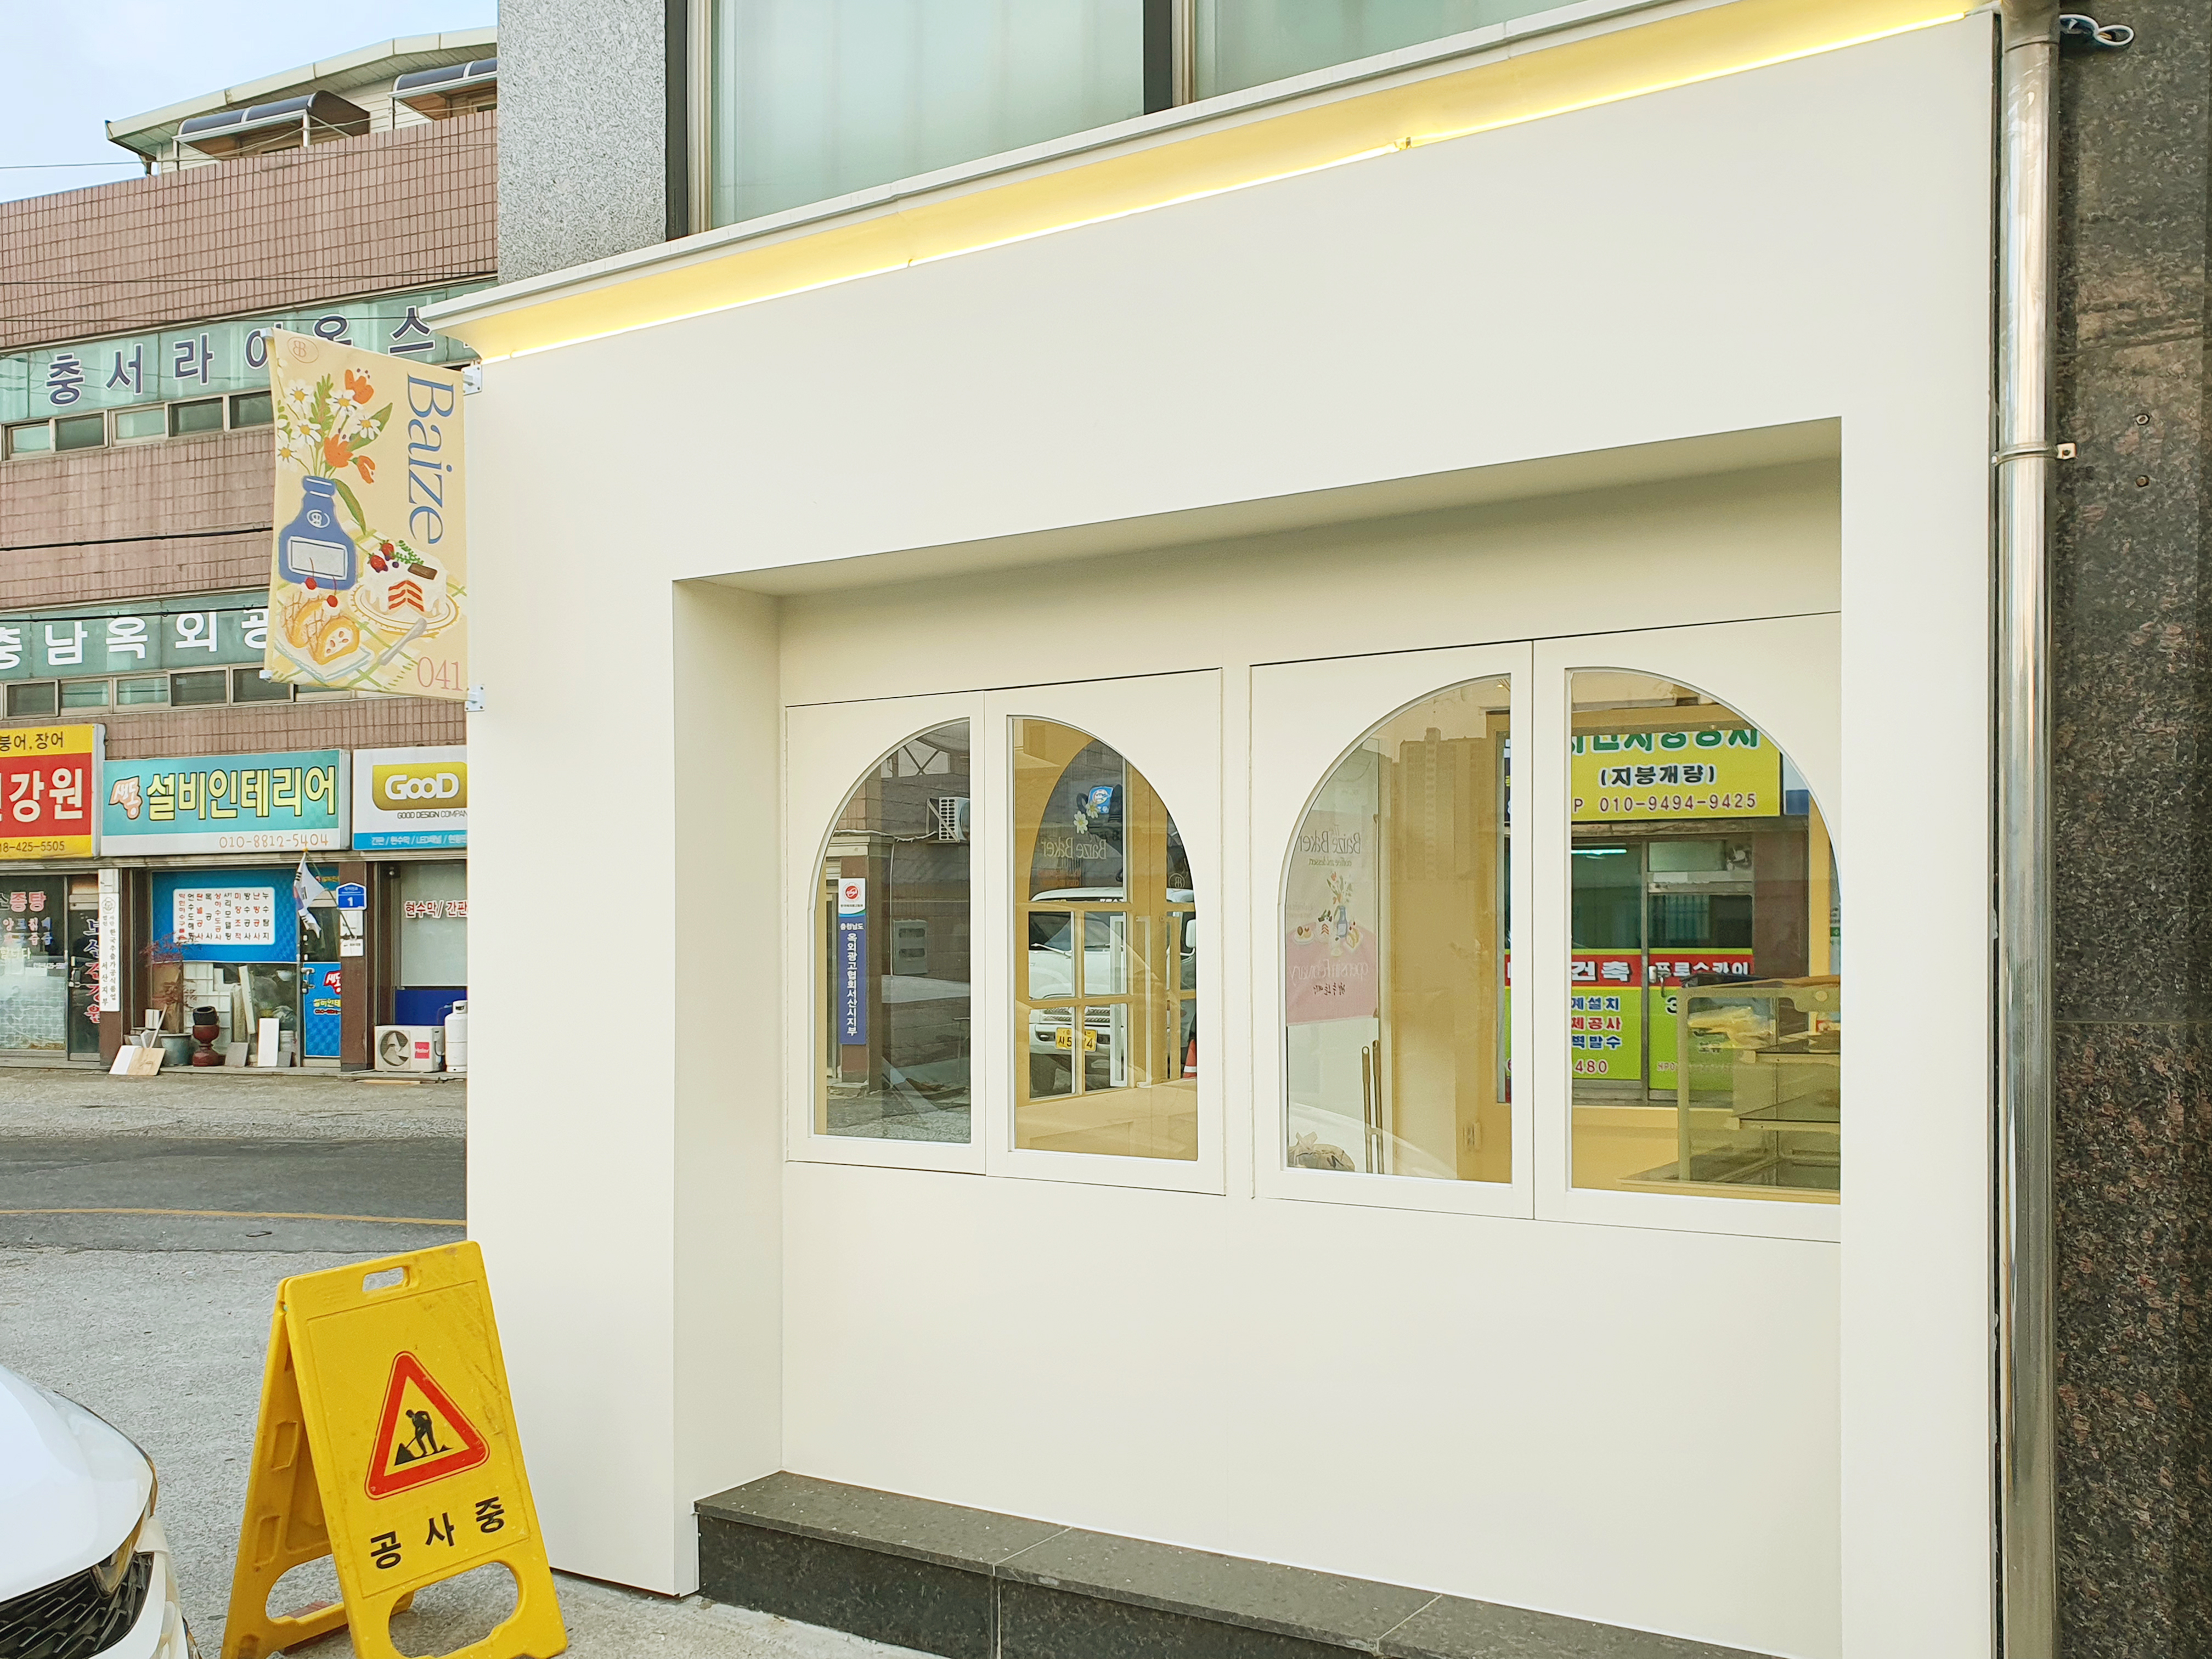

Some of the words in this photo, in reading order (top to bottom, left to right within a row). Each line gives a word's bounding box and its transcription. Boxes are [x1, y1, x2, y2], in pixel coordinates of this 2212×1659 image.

[407, 372, 455, 545] Baize
[417, 656, 464, 692] 041
[1600, 765, 1715, 786] (지붕개량)
[0, 768, 83, 823] 강원
[146, 765, 336, 821] 설비인테리어
[1599, 793, 1756, 813] 010-9494-9425
[219, 833, 329, 849] 010-8812-5404
[347, 896, 354, 907] 1
[445, 899, 467, 917] 간판
[847, 933, 857, 1036] 옥외광고협회서산시지부
